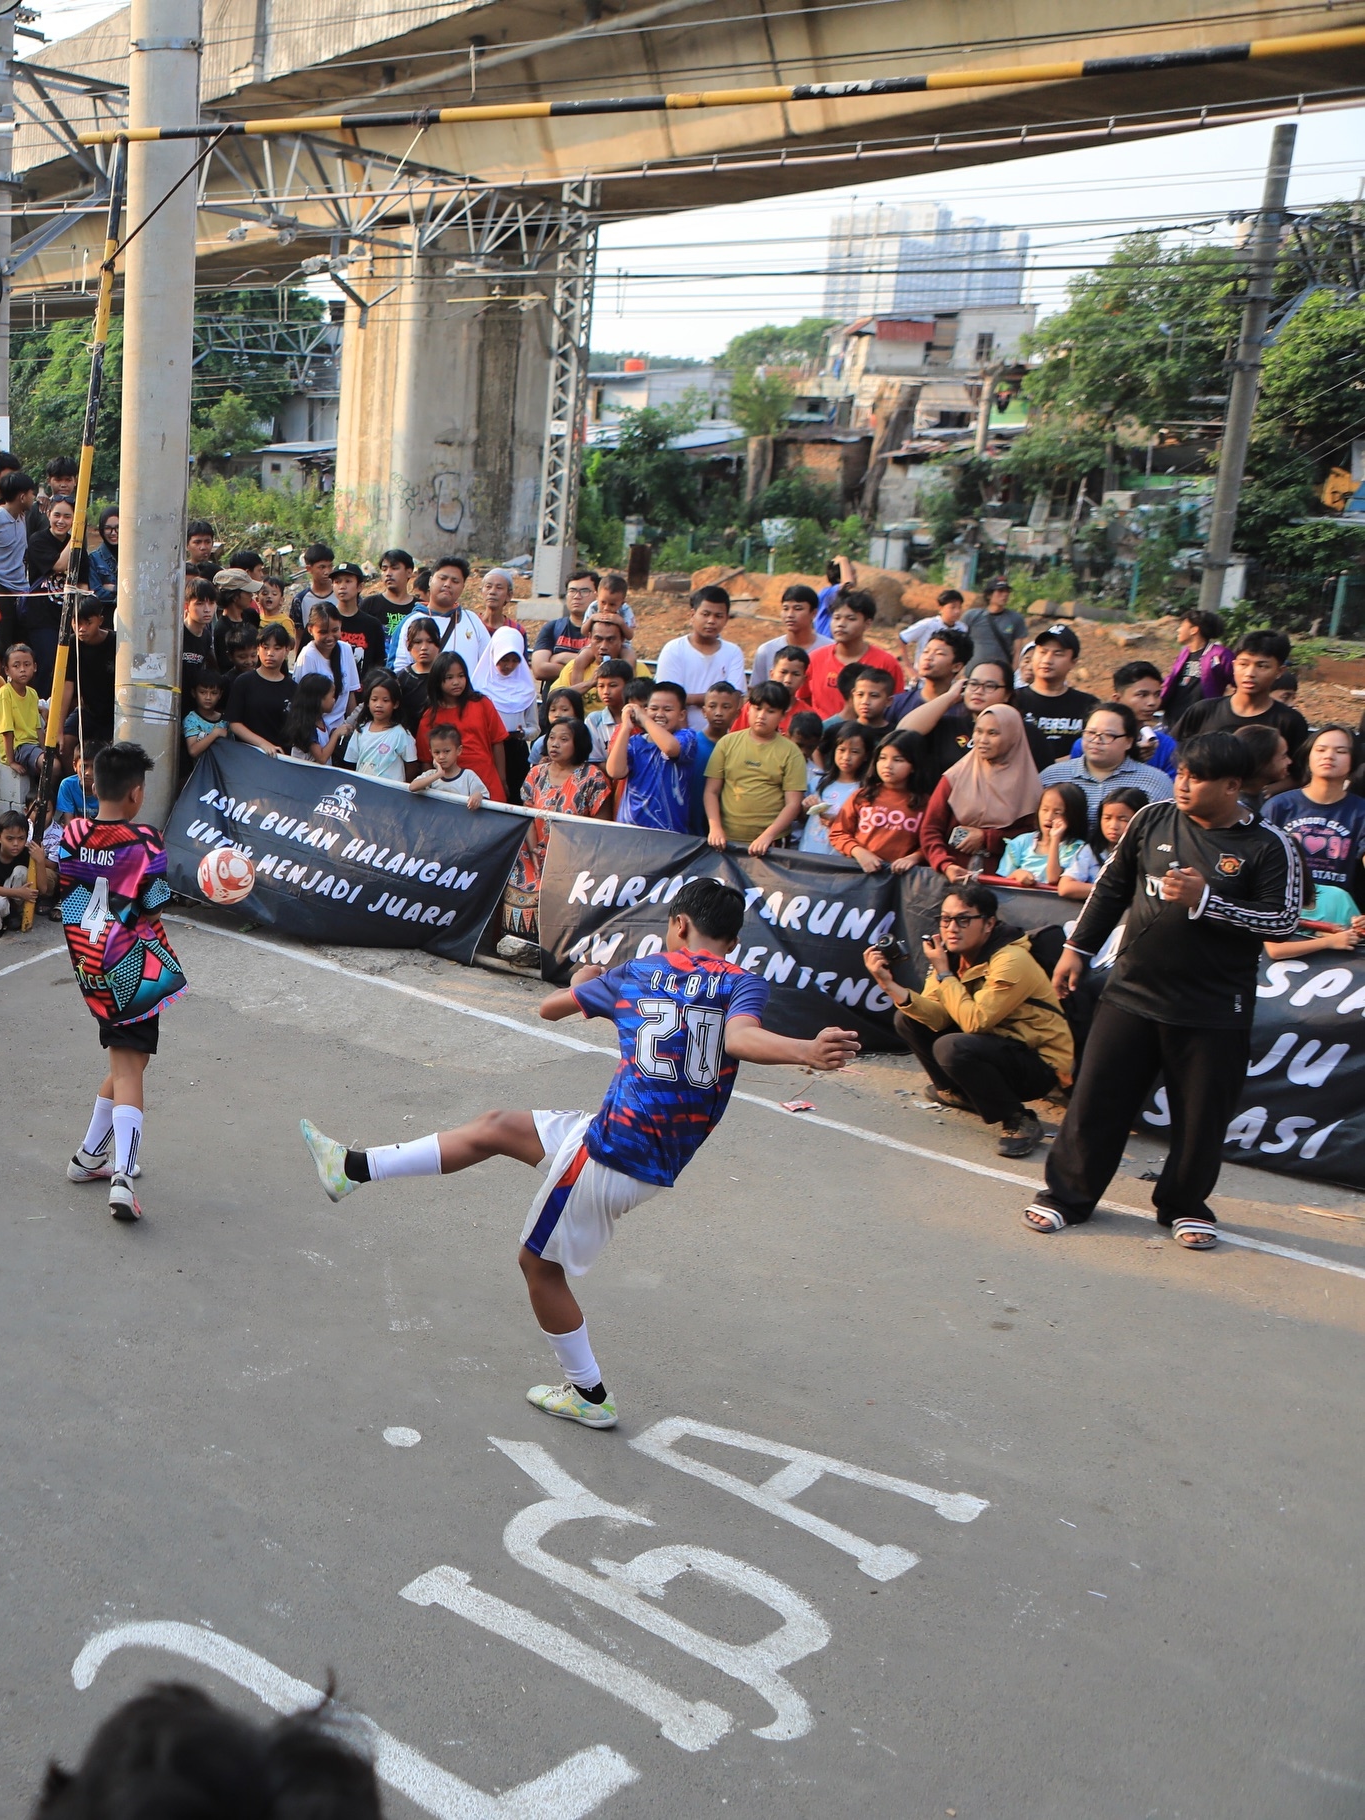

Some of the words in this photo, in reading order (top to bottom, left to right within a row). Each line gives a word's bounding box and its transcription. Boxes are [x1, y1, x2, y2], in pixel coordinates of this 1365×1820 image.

[1037, 716, 1084, 730] PERSIJA
[314, 802, 351, 822] ASPAL
[321, 798, 335, 806] LIGA
[858, 806, 924, 834] good
[1326, 820, 1351, 837] CLUB
[79, 846, 116, 867] BILQIS
[259, 811, 341, 852] BUKAN
[341, 837, 480, 892] HALANGAN
[255, 853, 363, 904] MENJADI
[367, 891, 458, 928] JUARA
[80, 876, 110, 945] 4
[569, 932, 625, 966] RW
[650, 969, 721, 999] ILBY
[635, 998, 725, 1090] 20
